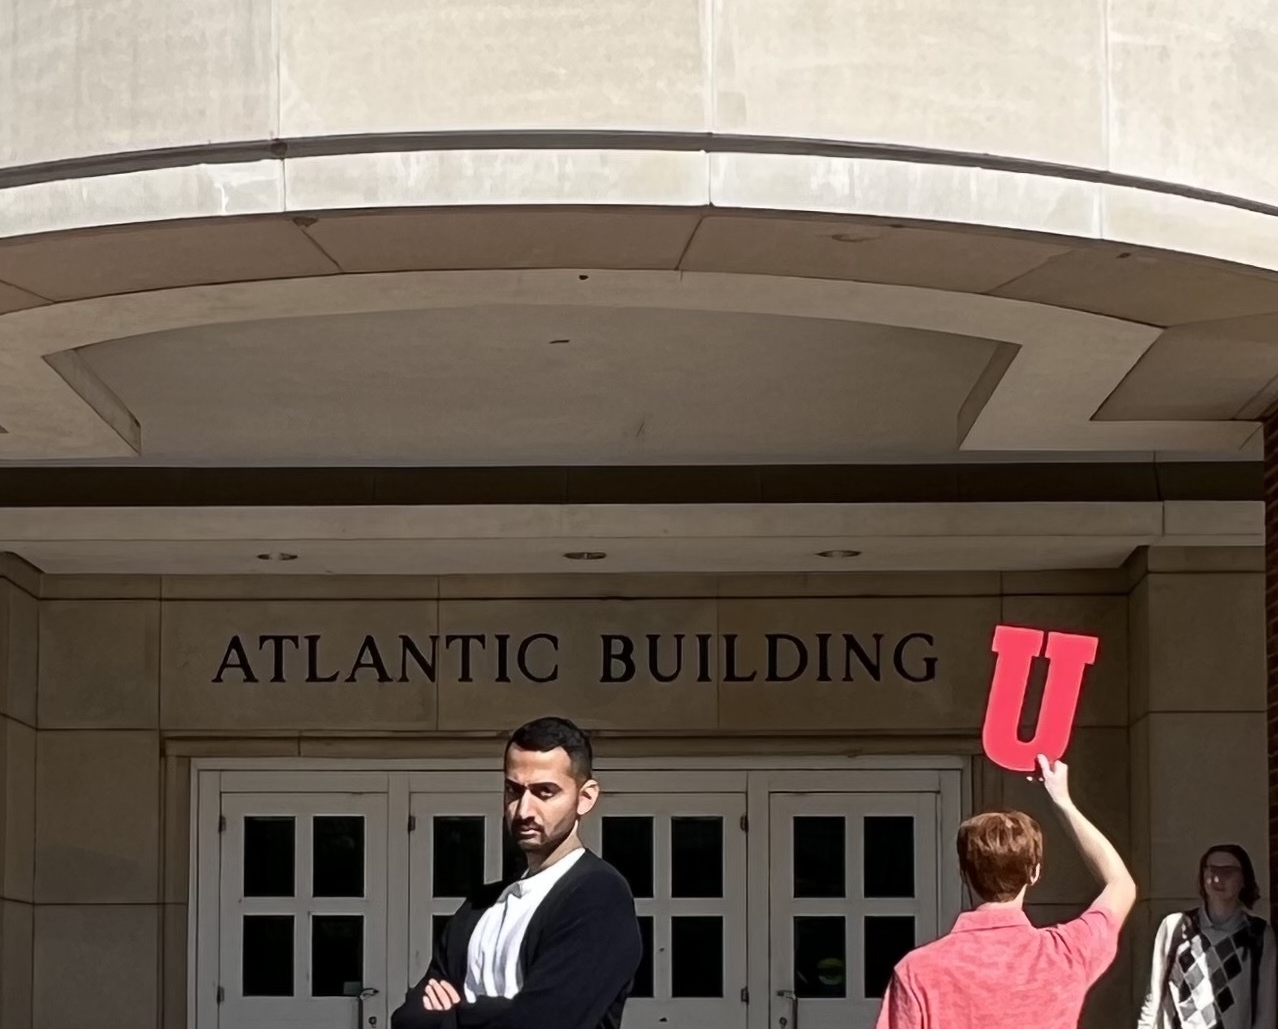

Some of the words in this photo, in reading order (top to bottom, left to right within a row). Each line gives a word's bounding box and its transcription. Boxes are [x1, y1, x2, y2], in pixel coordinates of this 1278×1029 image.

[211, 633, 559, 683] ATLANTIC
[600, 632, 939, 684] BUILDING
[983, 626, 1099, 772] U
